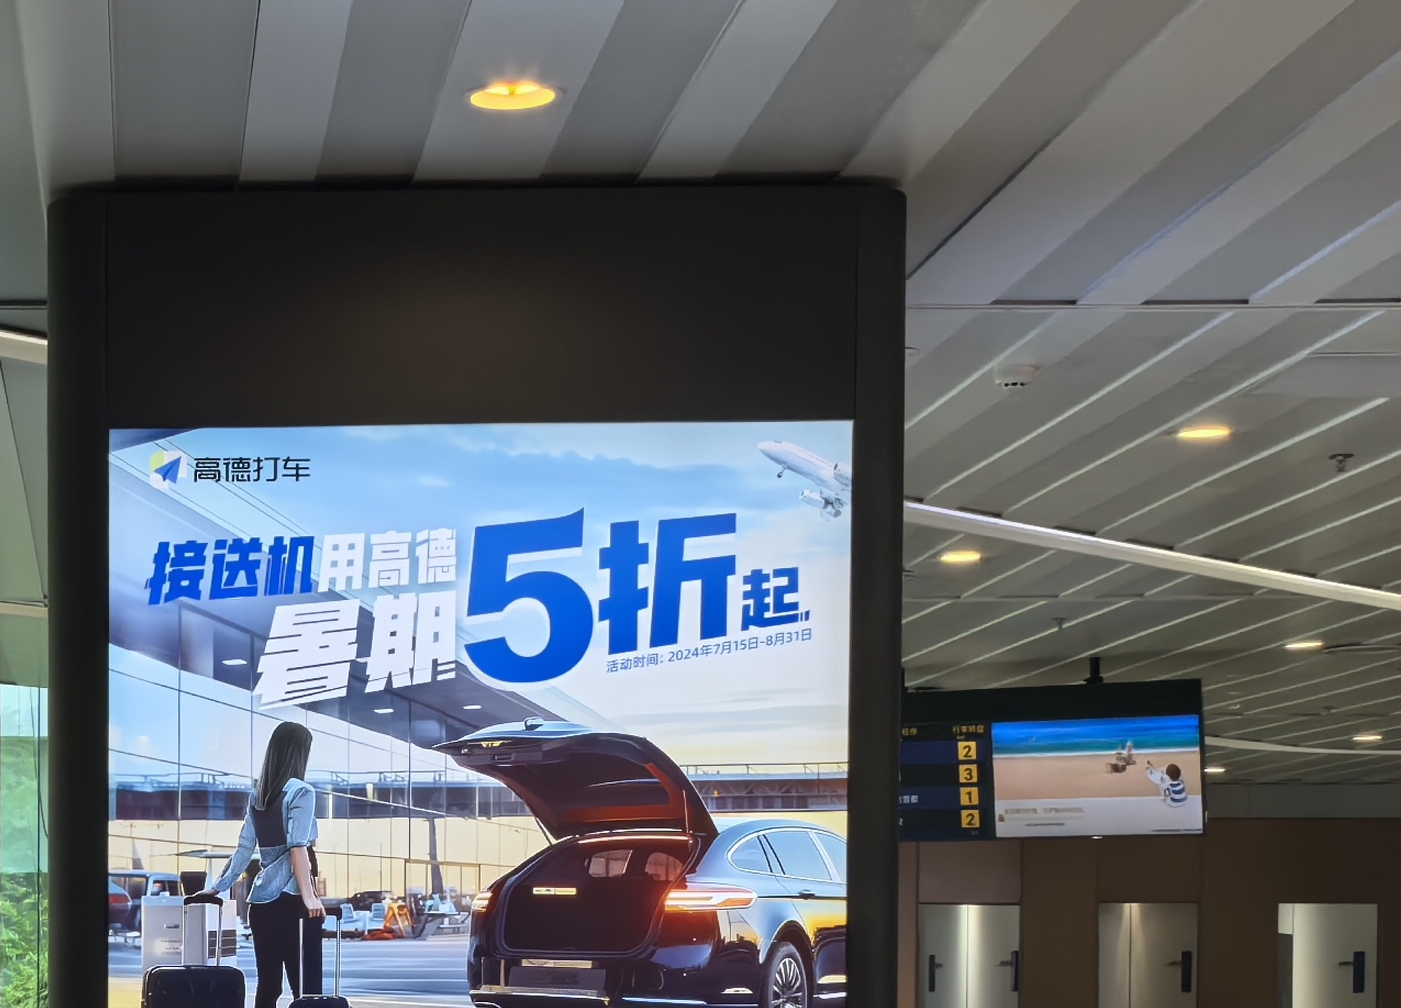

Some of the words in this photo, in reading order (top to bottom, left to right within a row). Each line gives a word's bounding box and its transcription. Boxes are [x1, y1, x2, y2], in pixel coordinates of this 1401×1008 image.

[193, 456, 311, 483] 高德打车
[144, 528, 456, 606] 接送机用高德
[464, 507, 810, 683] 5折起
[252, 590, 456, 710] 暑期
[962, 745, 973, 758] 2
[964, 767, 974, 781] 3
[965, 791, 973, 804] 1
[965, 813, 975, 826] 2
